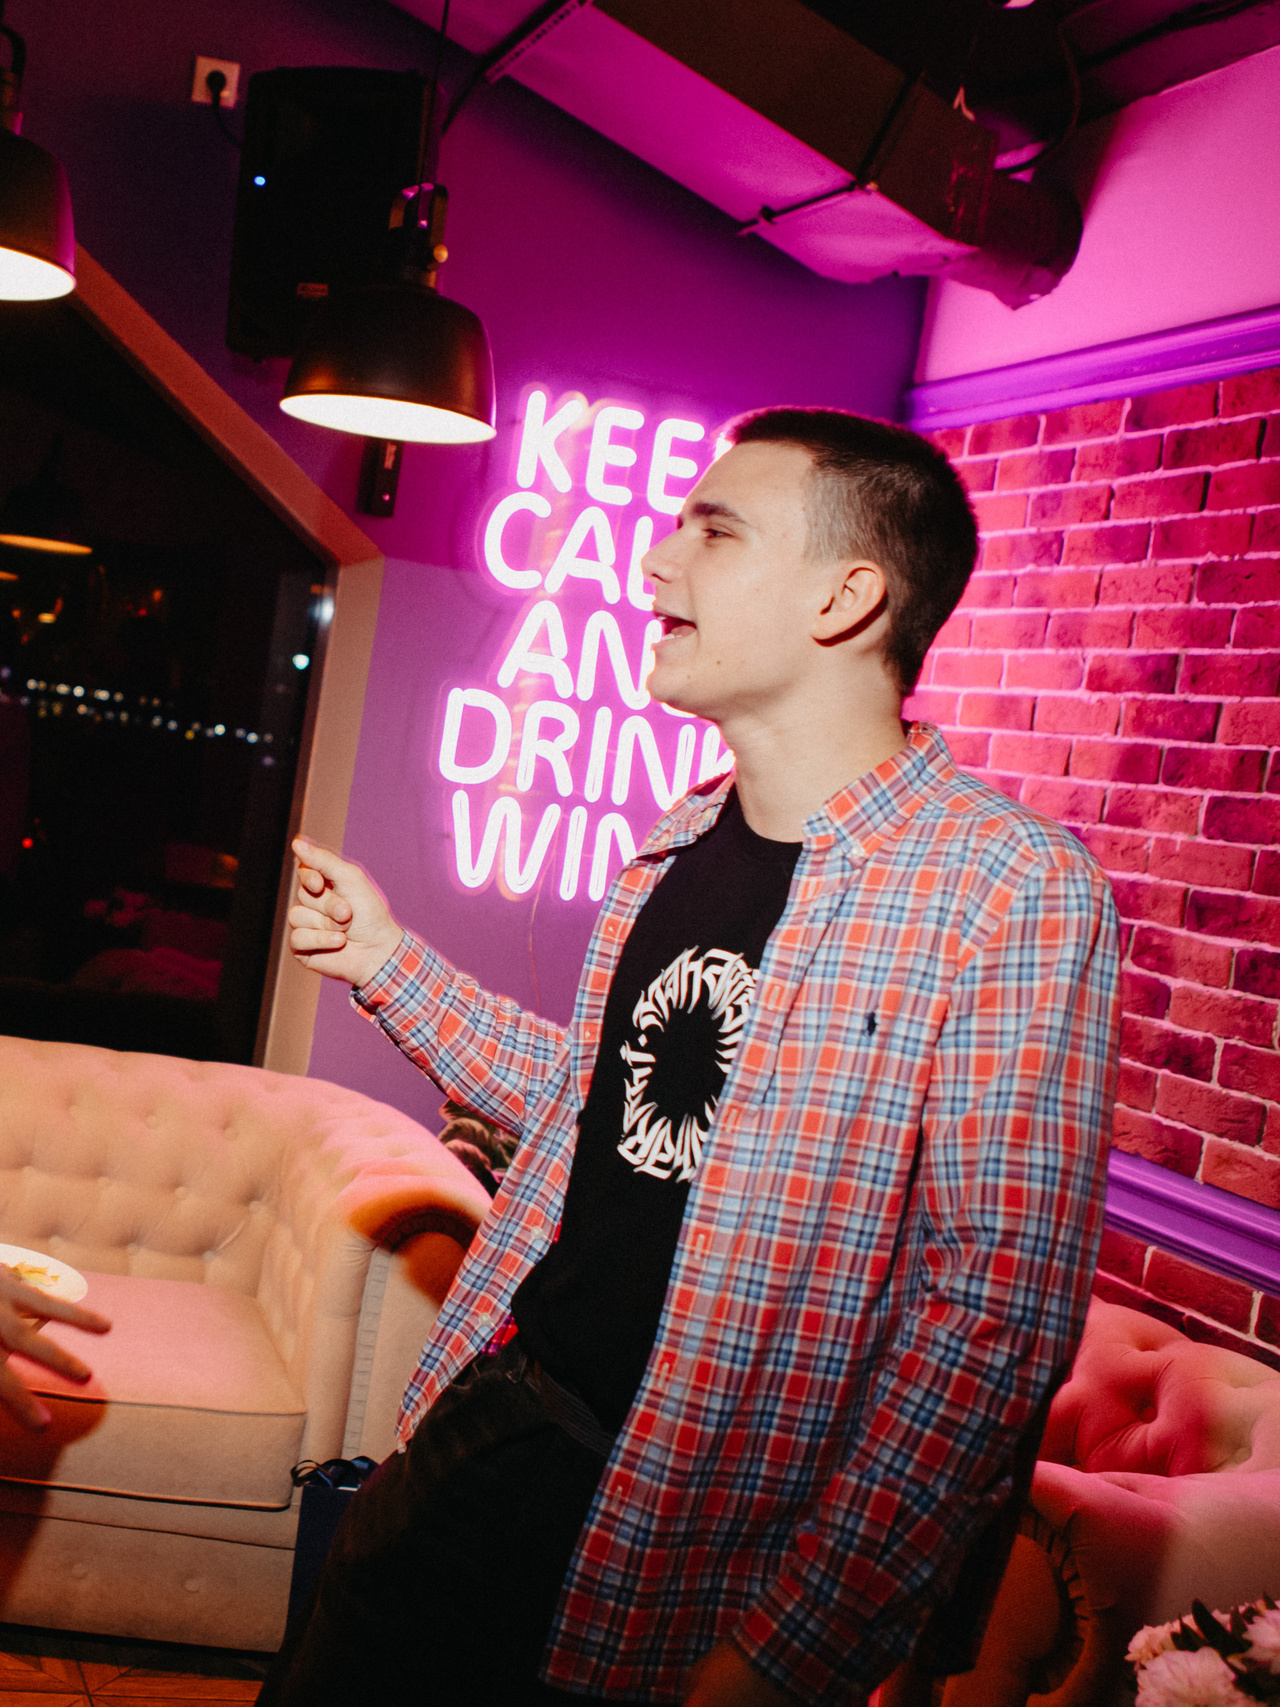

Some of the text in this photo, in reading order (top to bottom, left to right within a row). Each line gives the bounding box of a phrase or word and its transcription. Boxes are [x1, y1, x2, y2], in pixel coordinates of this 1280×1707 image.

[517, 390, 734, 515] KEE
[484, 491, 656, 611] CAL
[497, 600, 697, 718] AN
[452, 789, 637, 901] WIN
